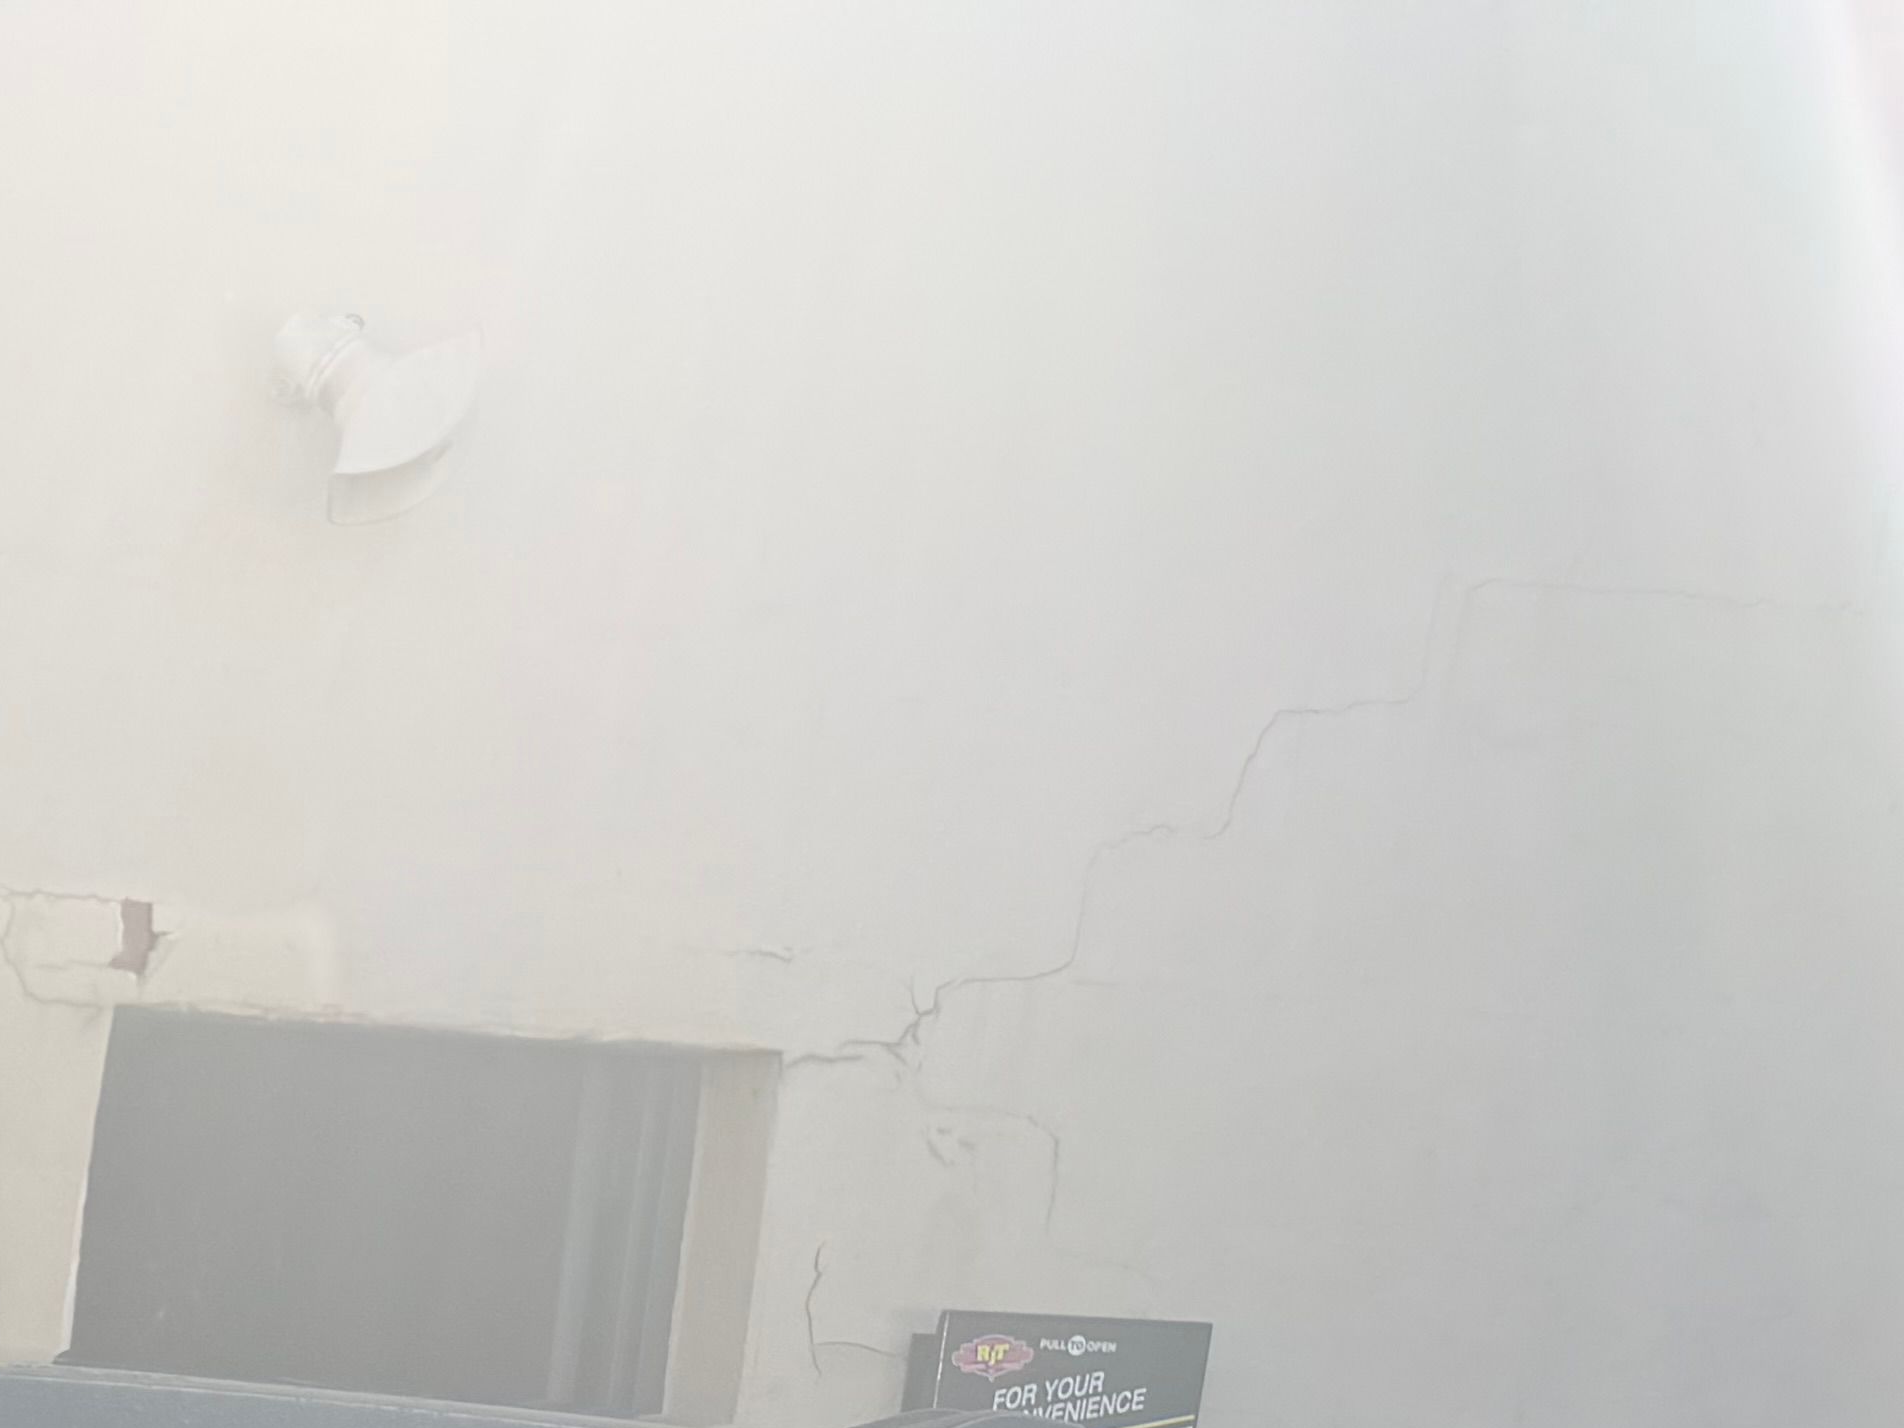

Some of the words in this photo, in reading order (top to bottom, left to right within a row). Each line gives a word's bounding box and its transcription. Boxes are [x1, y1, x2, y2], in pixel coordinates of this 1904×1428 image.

[1039, 1337, 1066, 1351] PULL
[1086, 1340, 1117, 1353] OPEN
[992, 1383, 1038, 1412] FOR
[1045, 1370, 1105, 1402] YOUR
